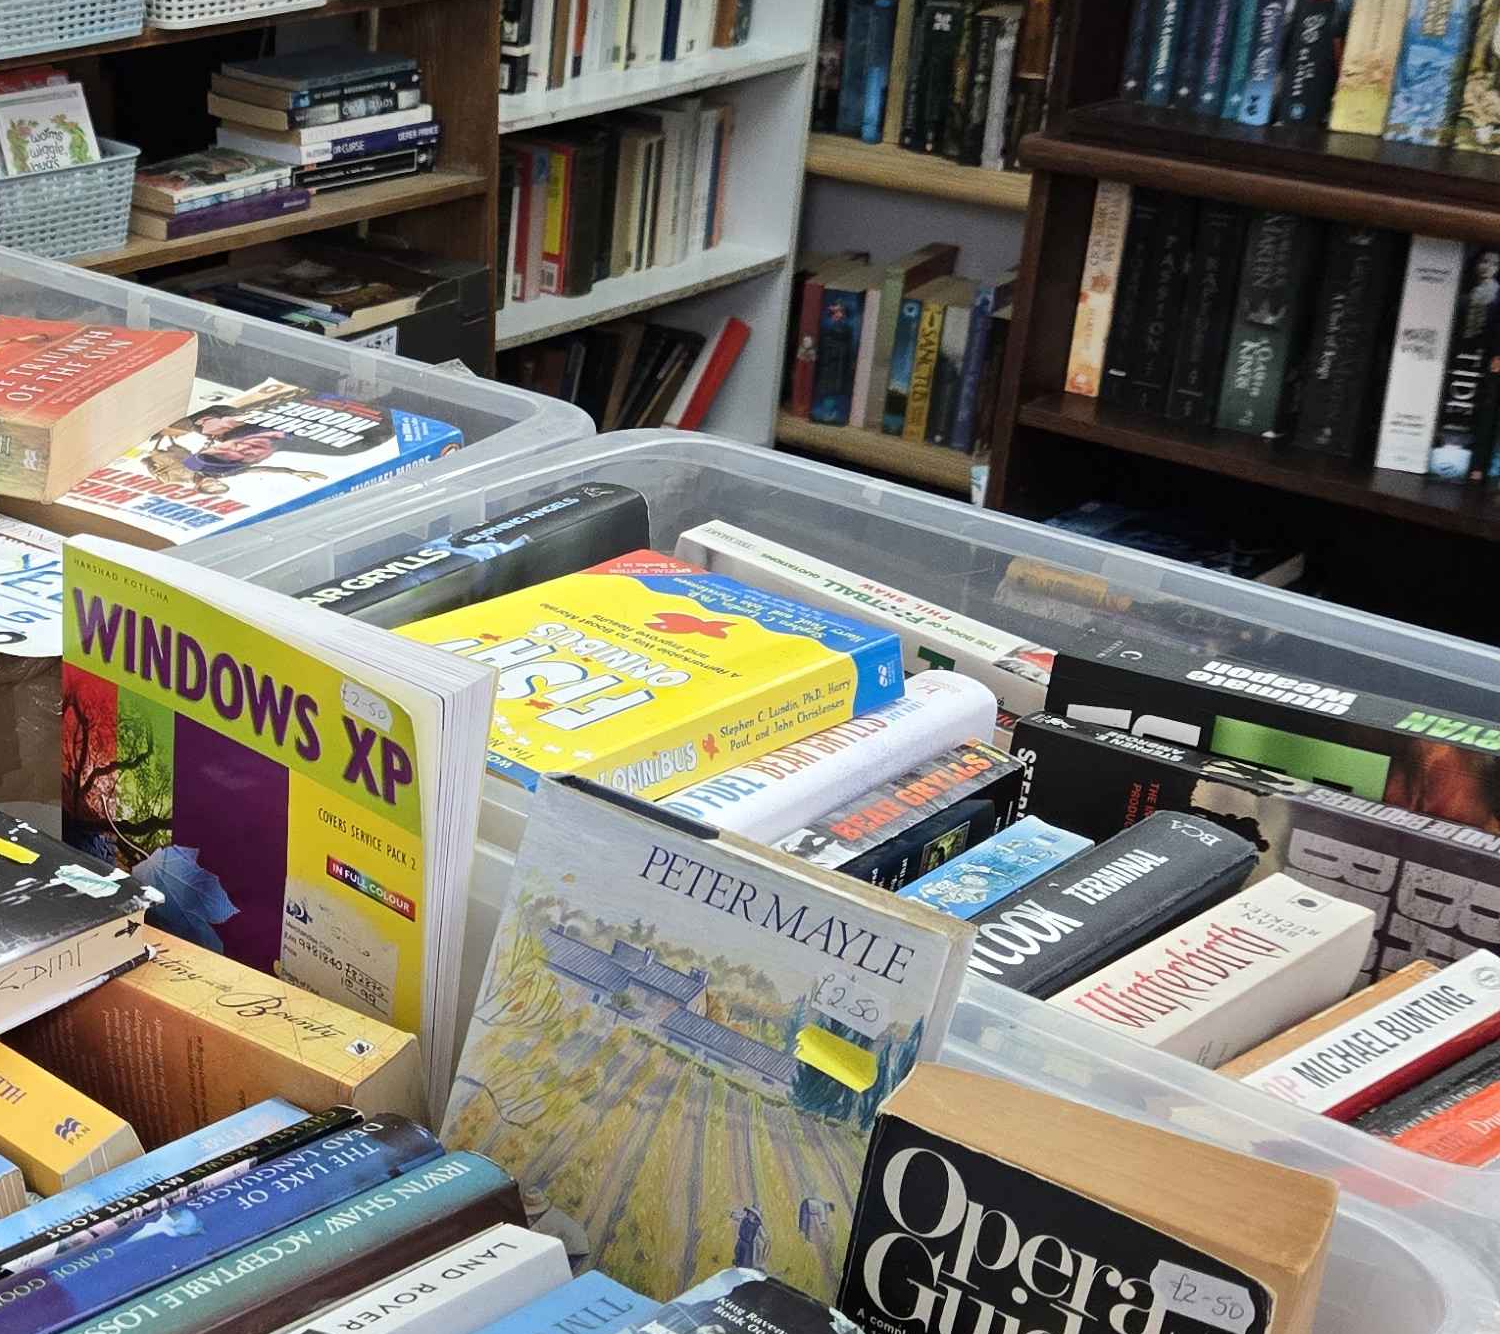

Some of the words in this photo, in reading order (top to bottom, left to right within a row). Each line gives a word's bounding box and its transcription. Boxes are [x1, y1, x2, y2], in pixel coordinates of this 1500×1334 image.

[46, 356, 86, 388] THE
[86, 335, 133, 369] SUN
[524, 496, 580, 524] ANGELS
[72, 556, 120, 584] HARSHAD
[122, 574, 171, 604] KOTECHA
[349, 546, 450, 591] GRYLLS
[909, 601, 951, 622] PHIL
[72, 586, 322, 764] WINDOWS
[340, 713, 415, 809] XP
[1201, 659, 1358, 708] Weapon
[718, 718, 755, 739] Stephen
[775, 717, 796, 735] John
[796, 696, 847, 727] Christensen
[611, 738, 699, 797] OMNIBUS
[701, 772, 762, 814] FUEL
[829, 796, 891, 843] BEAR
[895, 751, 994, 809] GRYLLS
[316, 806, 349, 836] COVERS
[349, 823, 384, 853] SERVICE
[386, 843, 409, 866] PACK
[343, 869, 369, 892] FULL
[368, 880, 412, 916] COLOUR
[639, 843, 759, 924] PETER
[761, 891, 915, 986] MAYLE
[979, 898, 1083, 979] COOK
[1062, 847, 1170, 907] TERMINAL
[1074, 921, 1290, 1031] Winterbirth
[1298, 1030, 1393, 1090] MICHAEL
[1395, 984, 1474, 1047] BUNTING
[324, 1119, 386, 1157] DEAD
[336, 1139, 379, 1175] THE
[186, 1148, 319, 1213] LANGUAGES
[268, 1157, 332, 1200] LAKE
[405, 1159, 472, 1203] IRWIN
[319, 1193, 399, 1236] SHAW
[157, 1221, 317, 1317] ACCEPTABLE
[441, 1238, 519, 1283] LAND
[343, 1279, 439, 1334] ROVER
[573, 1295, 635, 1334] TIM
[712, 1305, 744, 1325] Book
[716, 1295, 745, 1319] King
